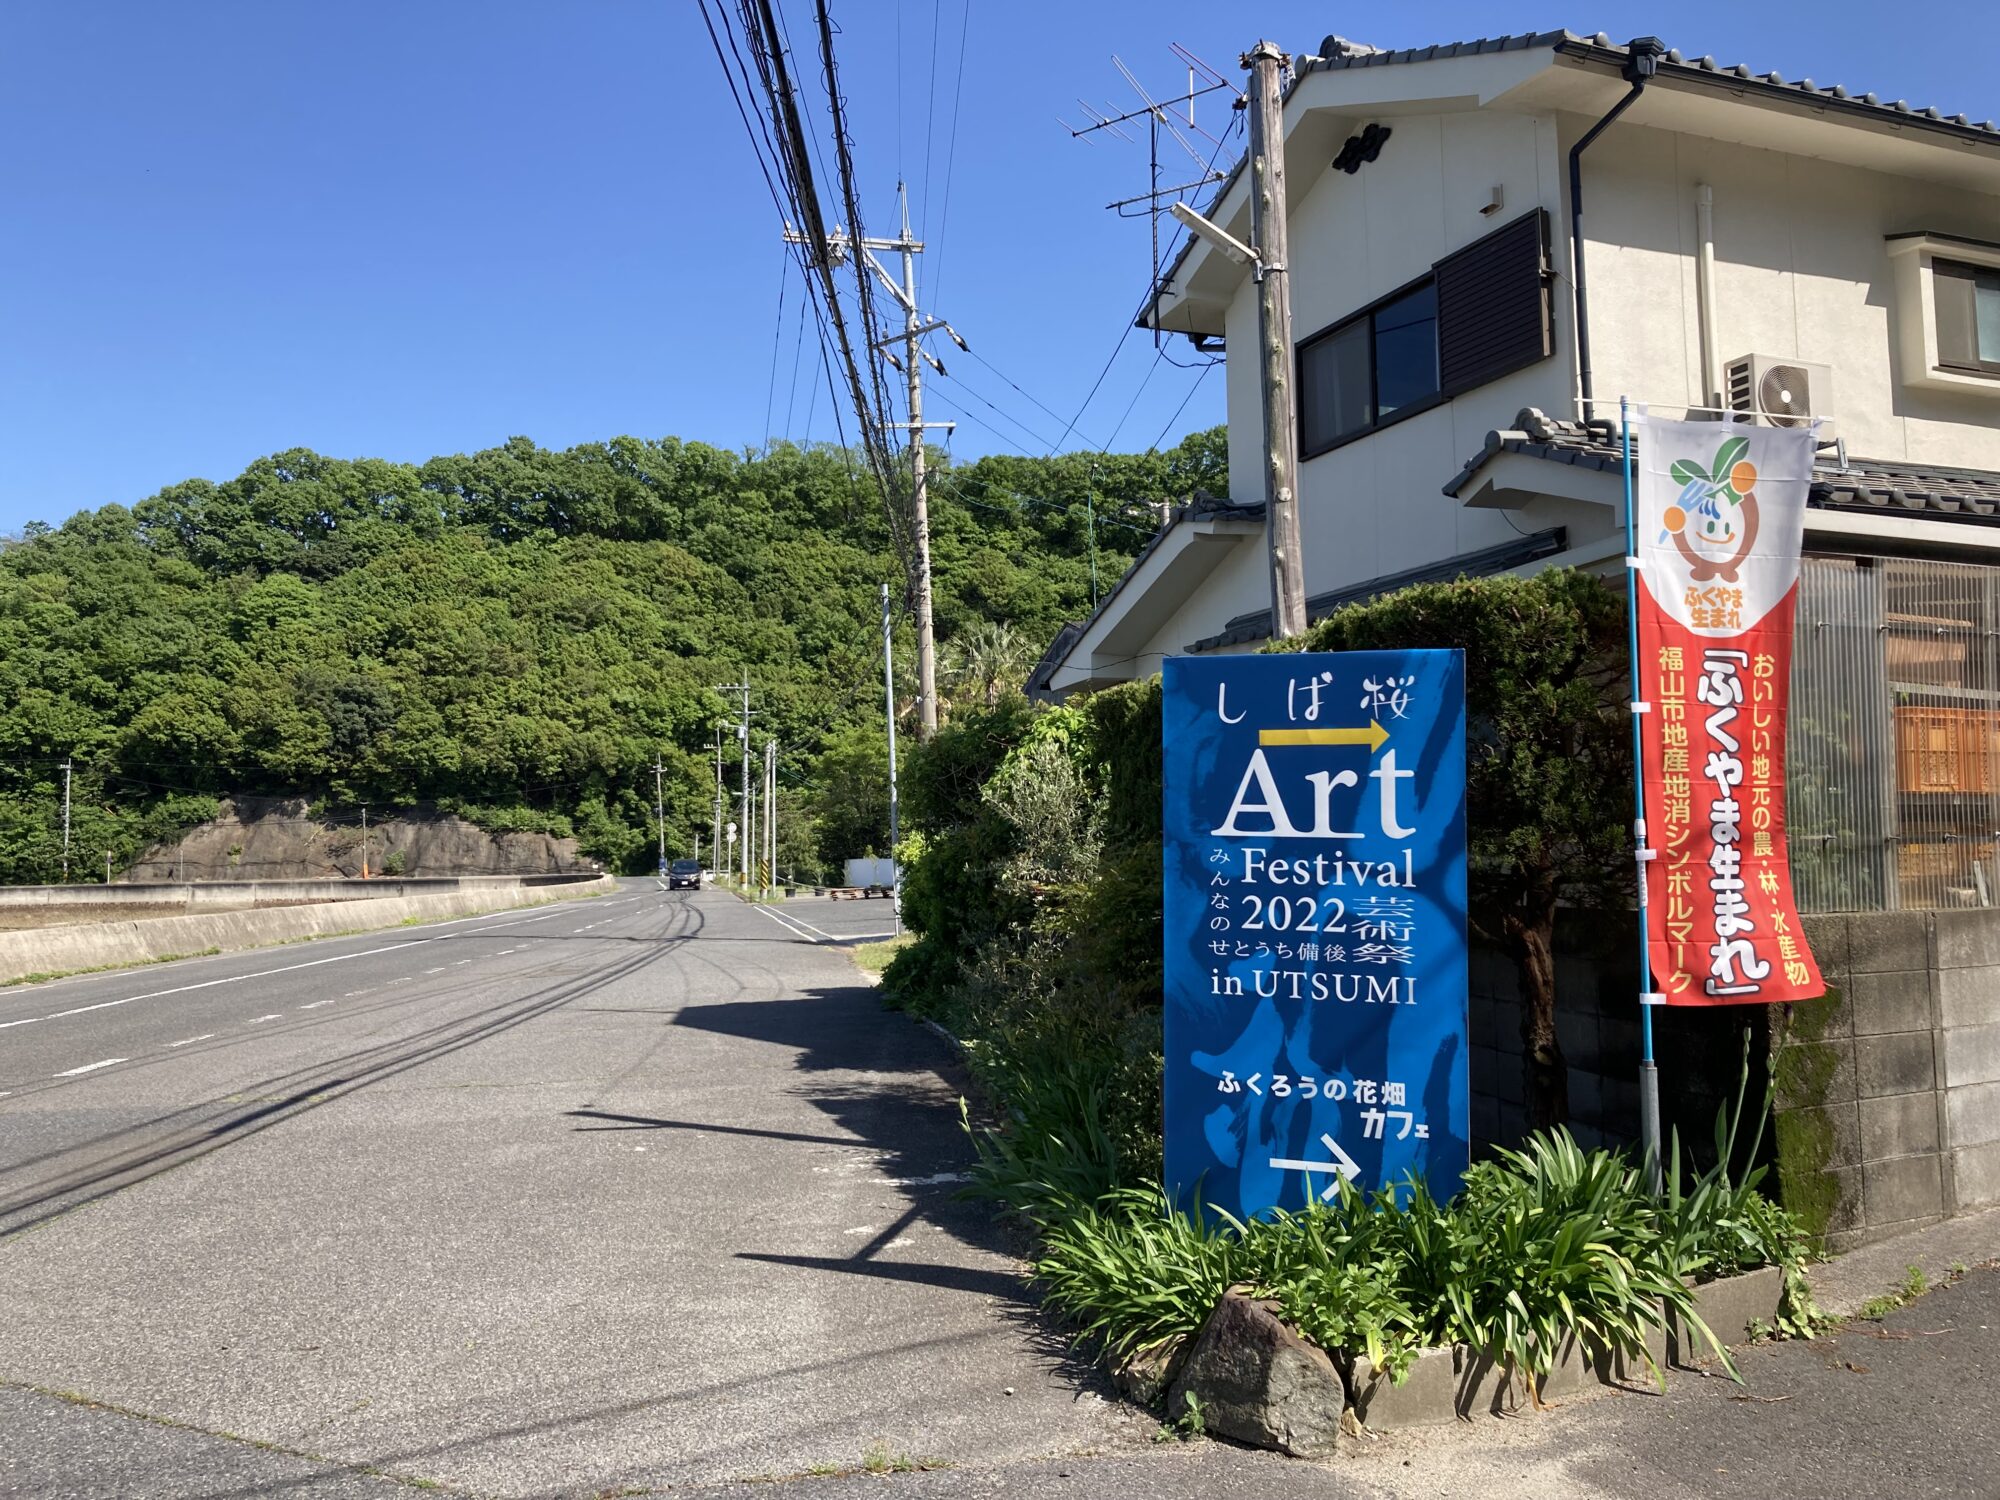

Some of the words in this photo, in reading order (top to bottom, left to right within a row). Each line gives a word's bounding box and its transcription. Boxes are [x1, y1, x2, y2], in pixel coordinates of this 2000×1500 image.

[1684, 586, 1743, 608] ふくやま
[1690, 608, 1742, 629] 生まれ
[1210, 748, 1417, 839] Art
[1658, 646, 1694, 994] 福山市地産地消シンボルマーク
[1751, 653, 1810, 986] おいしい地元の農・林・水産物
[1241, 847, 1417, 888] Festival
[1209, 848, 1231, 931] みんなの
[1241, 895, 1347, 933] 2022
[1351, 896, 1416, 965] 芸術祭
[1208, 940, 1347, 963] せとうち備後
[1210, 968, 1242, 996] in
[1252, 970, 1418, 1005] UTSUMI
[1217, 1070, 1406, 1107] ふくろうの花畑
[1360, 1107, 1430, 1140] カフェ
